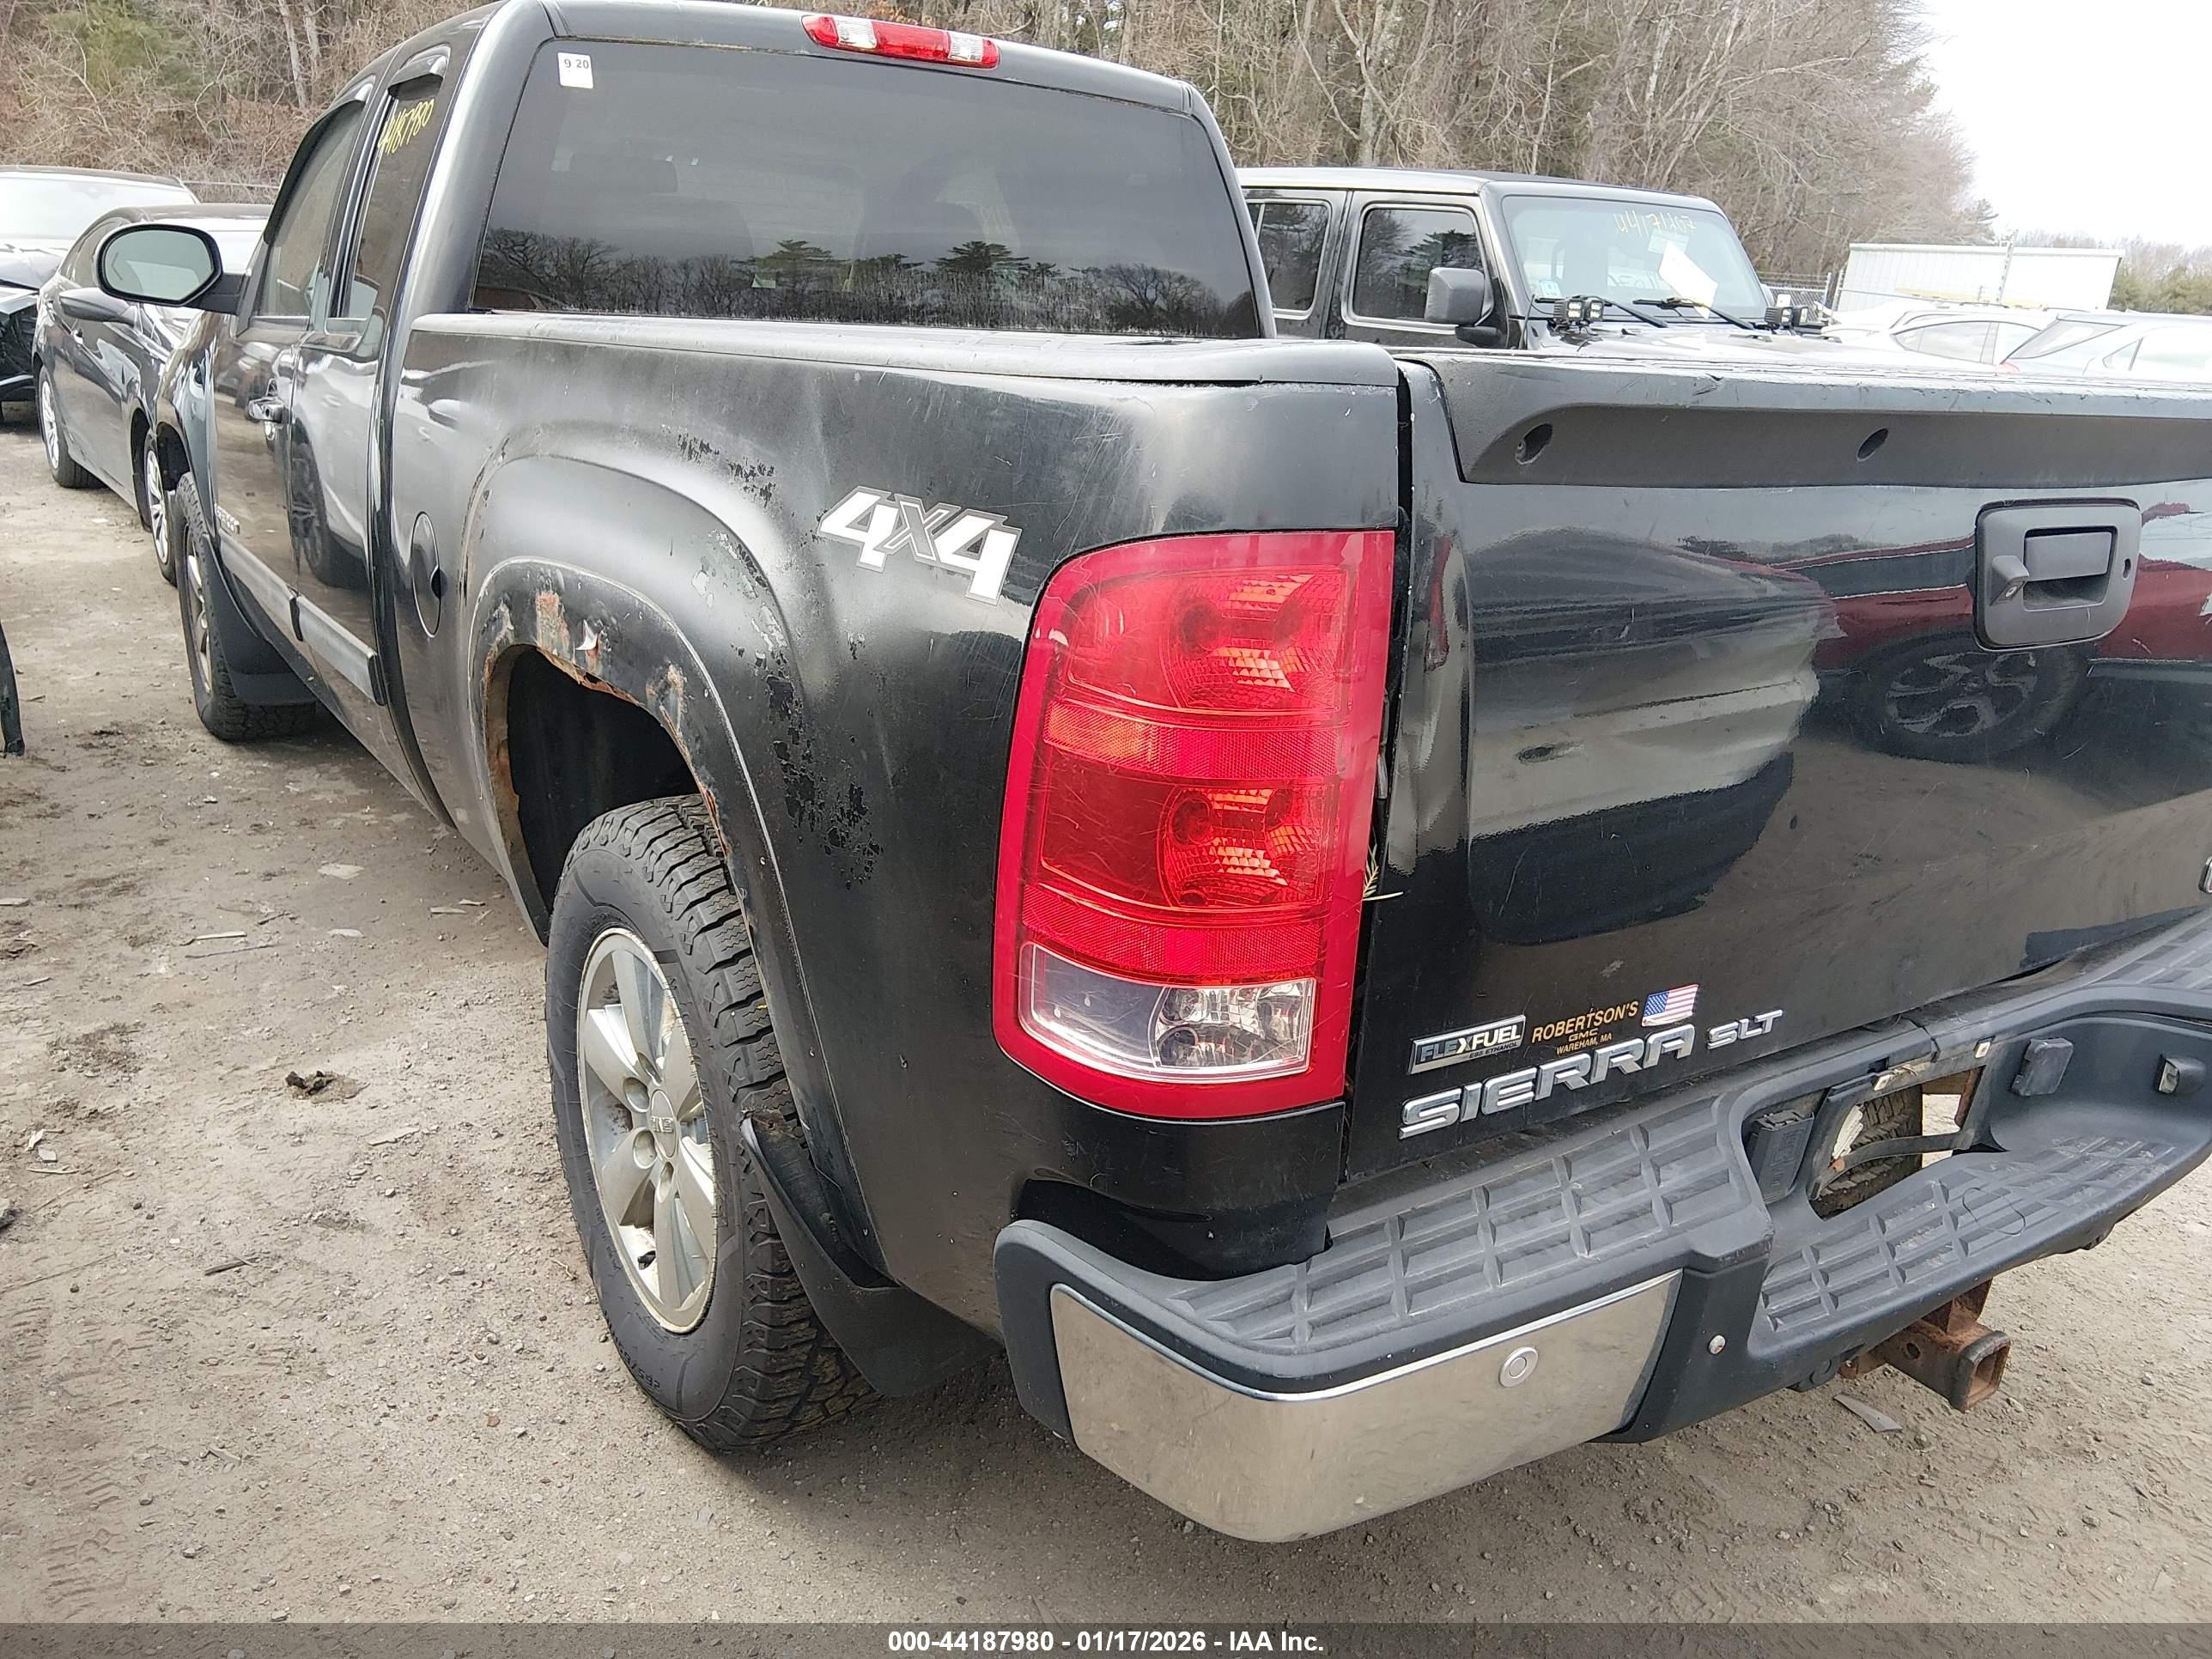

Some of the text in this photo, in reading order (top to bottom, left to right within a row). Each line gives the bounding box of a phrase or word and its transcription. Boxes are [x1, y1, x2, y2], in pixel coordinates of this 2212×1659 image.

[564, 58, 590, 70] 9 20
[1531, 1000, 1639, 1043] ROBERTSON'S
[1568, 1027, 1599, 1042] GMC
[1706, 1009, 1784, 1050] SLT
[1419, 1024, 1522, 1062] FLEXFUEL
[1468, 1041, 1519, 1060] E85 ETHANOL
[1556, 1032, 1613, 1055] WAREHAM, MA
[1398, 1024, 1696, 1140] SIERRA
